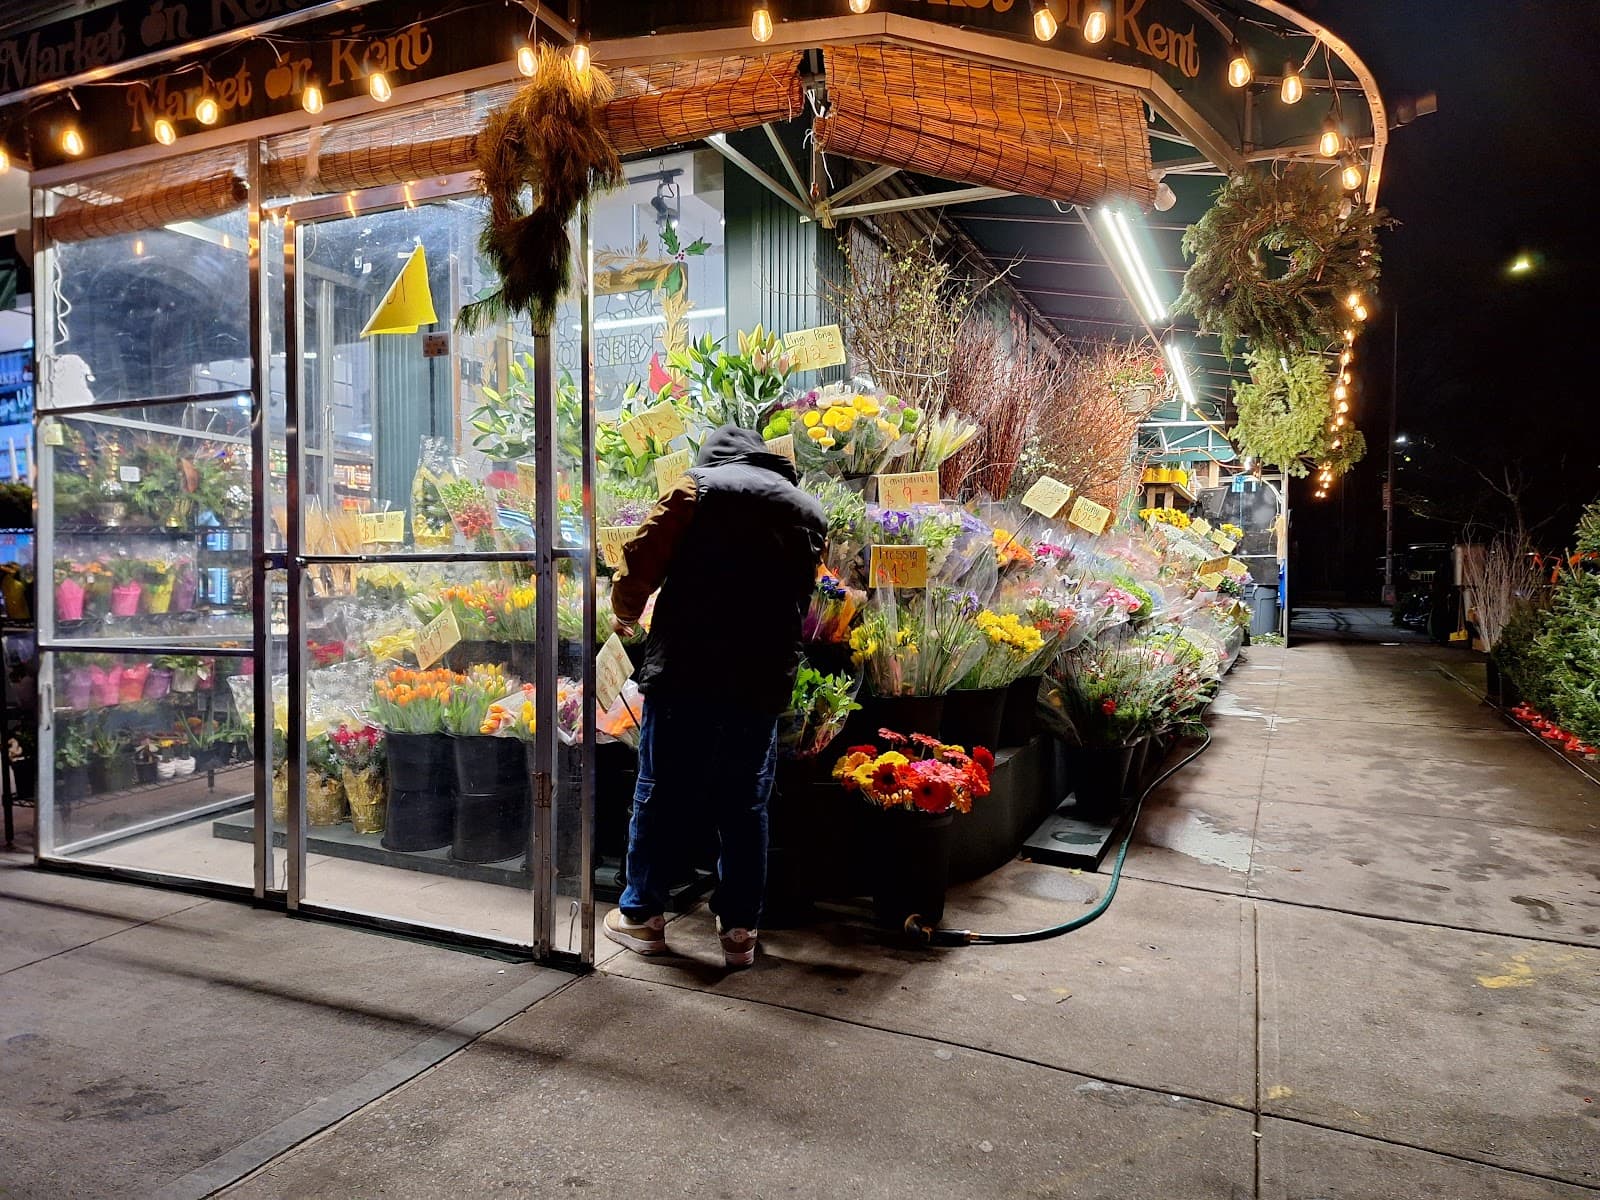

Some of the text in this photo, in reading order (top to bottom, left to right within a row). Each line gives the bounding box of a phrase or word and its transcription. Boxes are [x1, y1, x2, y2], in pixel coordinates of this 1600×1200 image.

[0, 11, 126, 91] Market
[126, 57, 251, 132] Market
[328, 20, 432, 87] Kent
[1112, 0, 1199, 78] Kent
[813, 329, 833, 343] Pong
